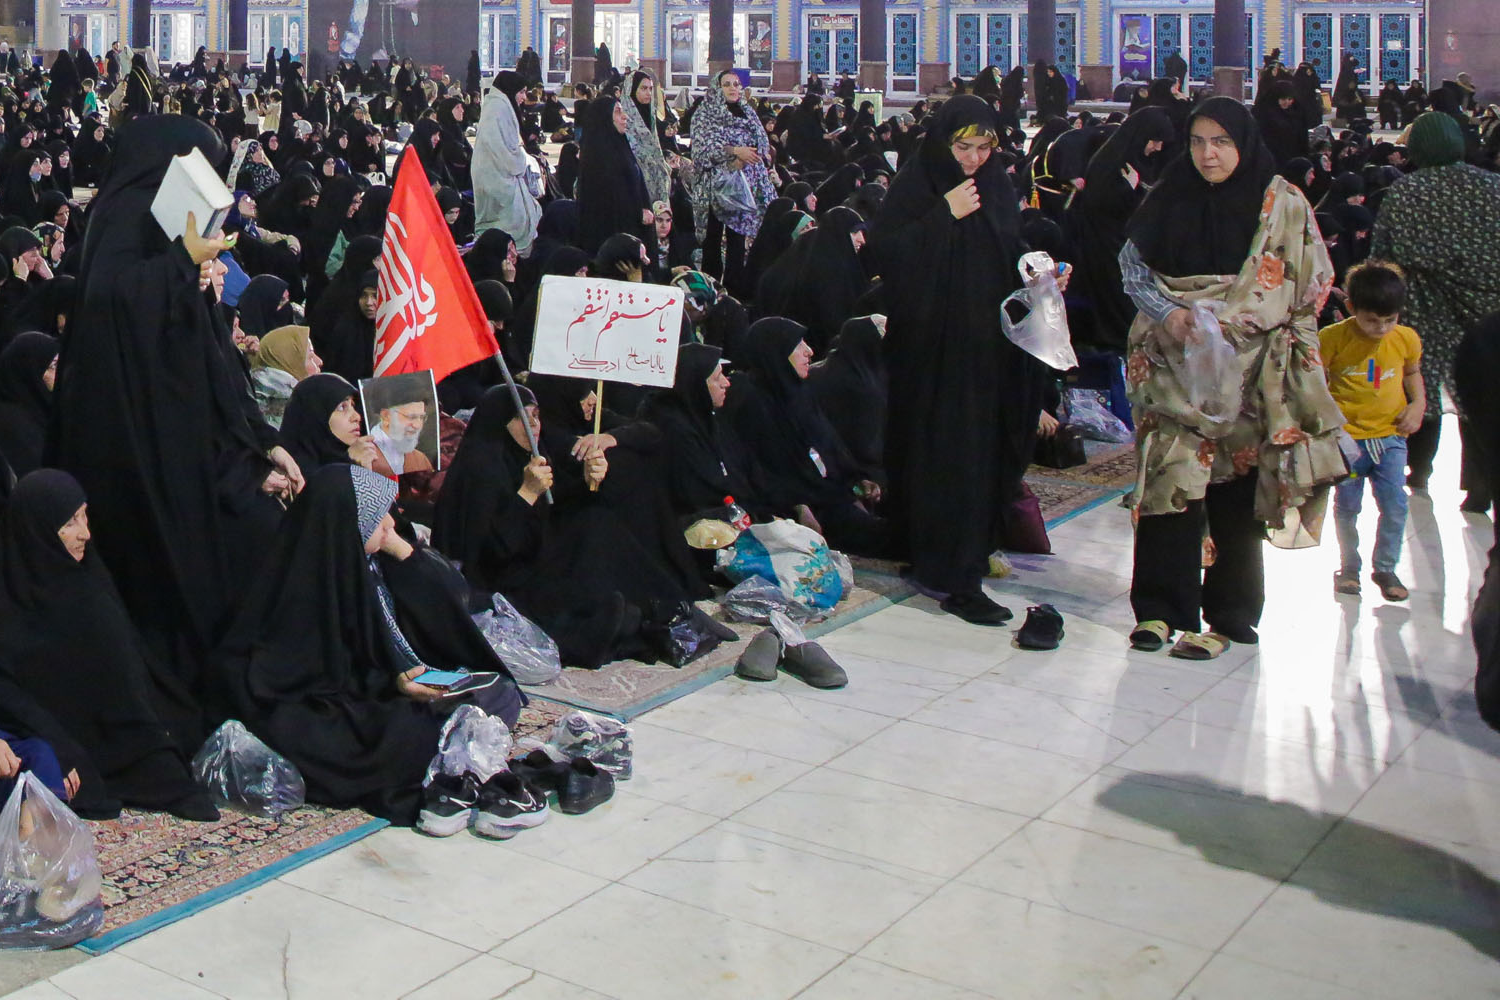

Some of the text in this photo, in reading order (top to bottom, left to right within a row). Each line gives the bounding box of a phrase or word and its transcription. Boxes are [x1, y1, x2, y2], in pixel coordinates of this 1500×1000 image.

[565, 287, 676, 361] یا منتقم انتقم
